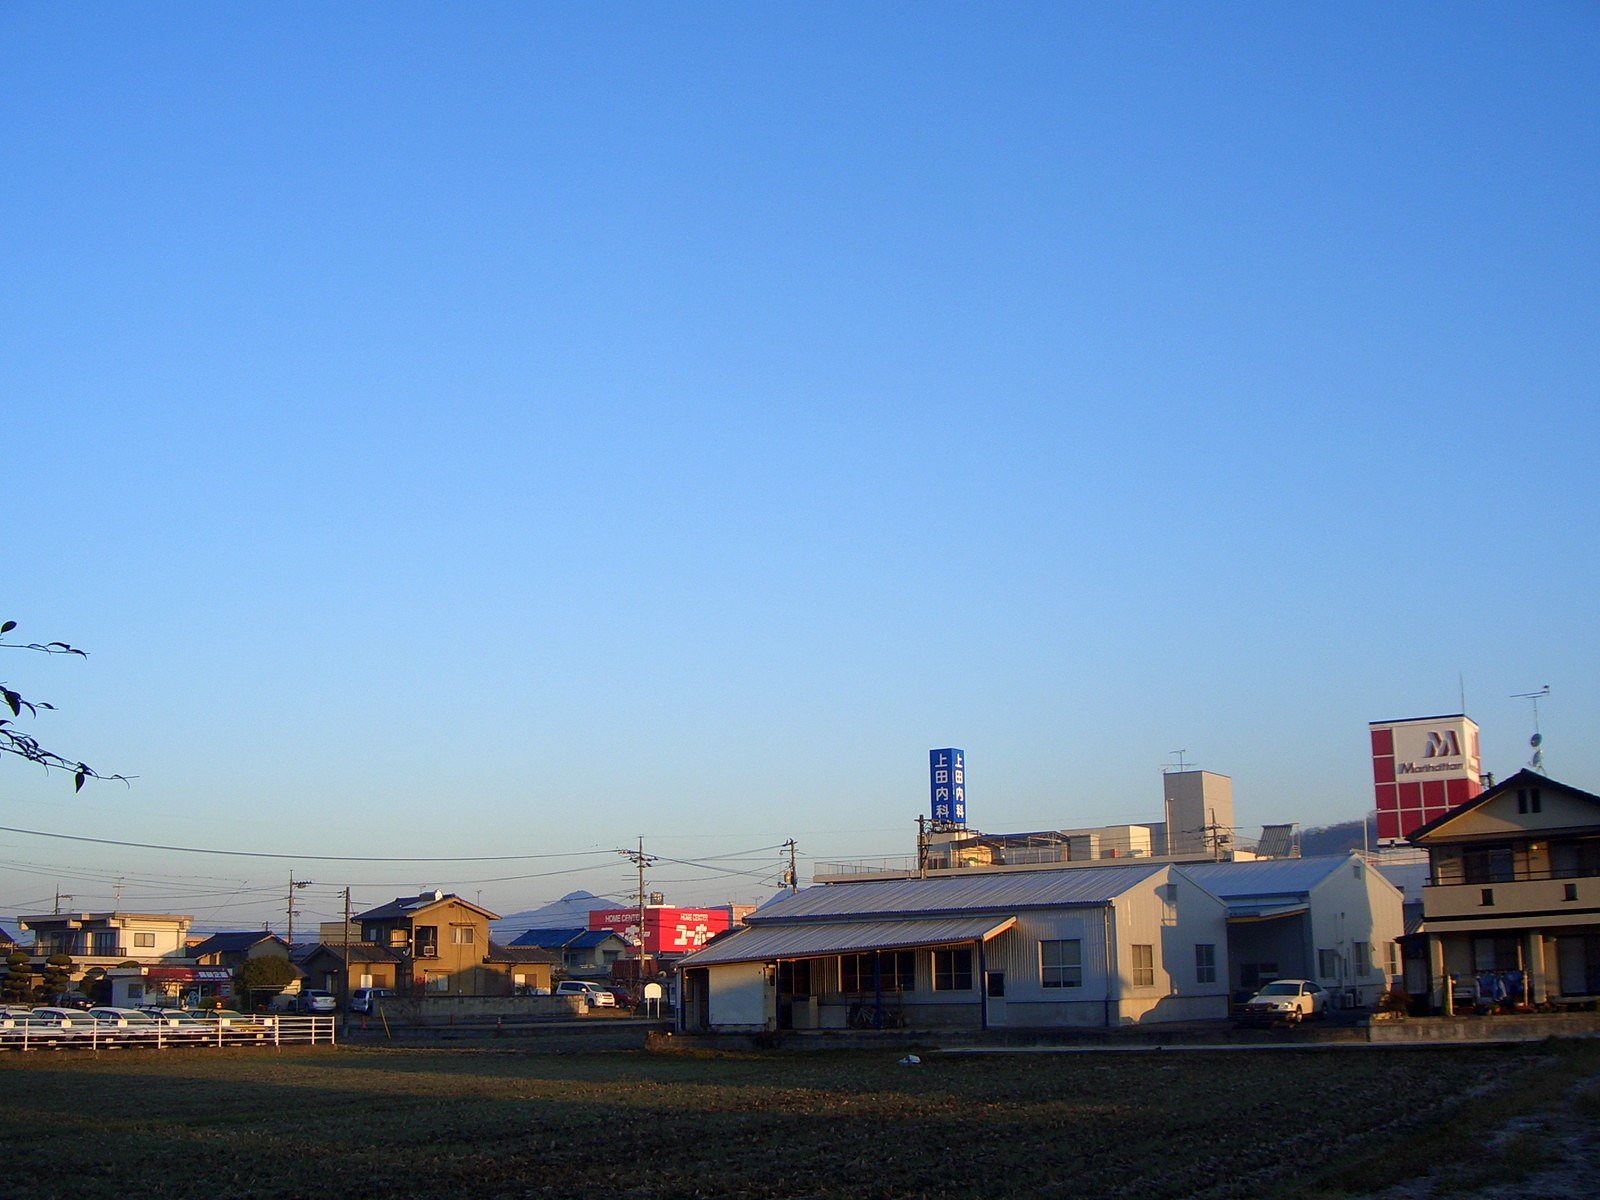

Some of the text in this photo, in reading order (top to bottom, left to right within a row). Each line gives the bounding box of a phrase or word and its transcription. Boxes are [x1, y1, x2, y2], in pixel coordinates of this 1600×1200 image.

[1397, 761, 1463, 774] Manhattan
[935, 754, 949, 818] 上田内科
[955, 754, 964, 819] 上田内科
[605, 913, 641, 923] HOME CENTE
[680, 913, 709, 921] HOME CENTER
[674, 923, 715, 945] ユーホー
